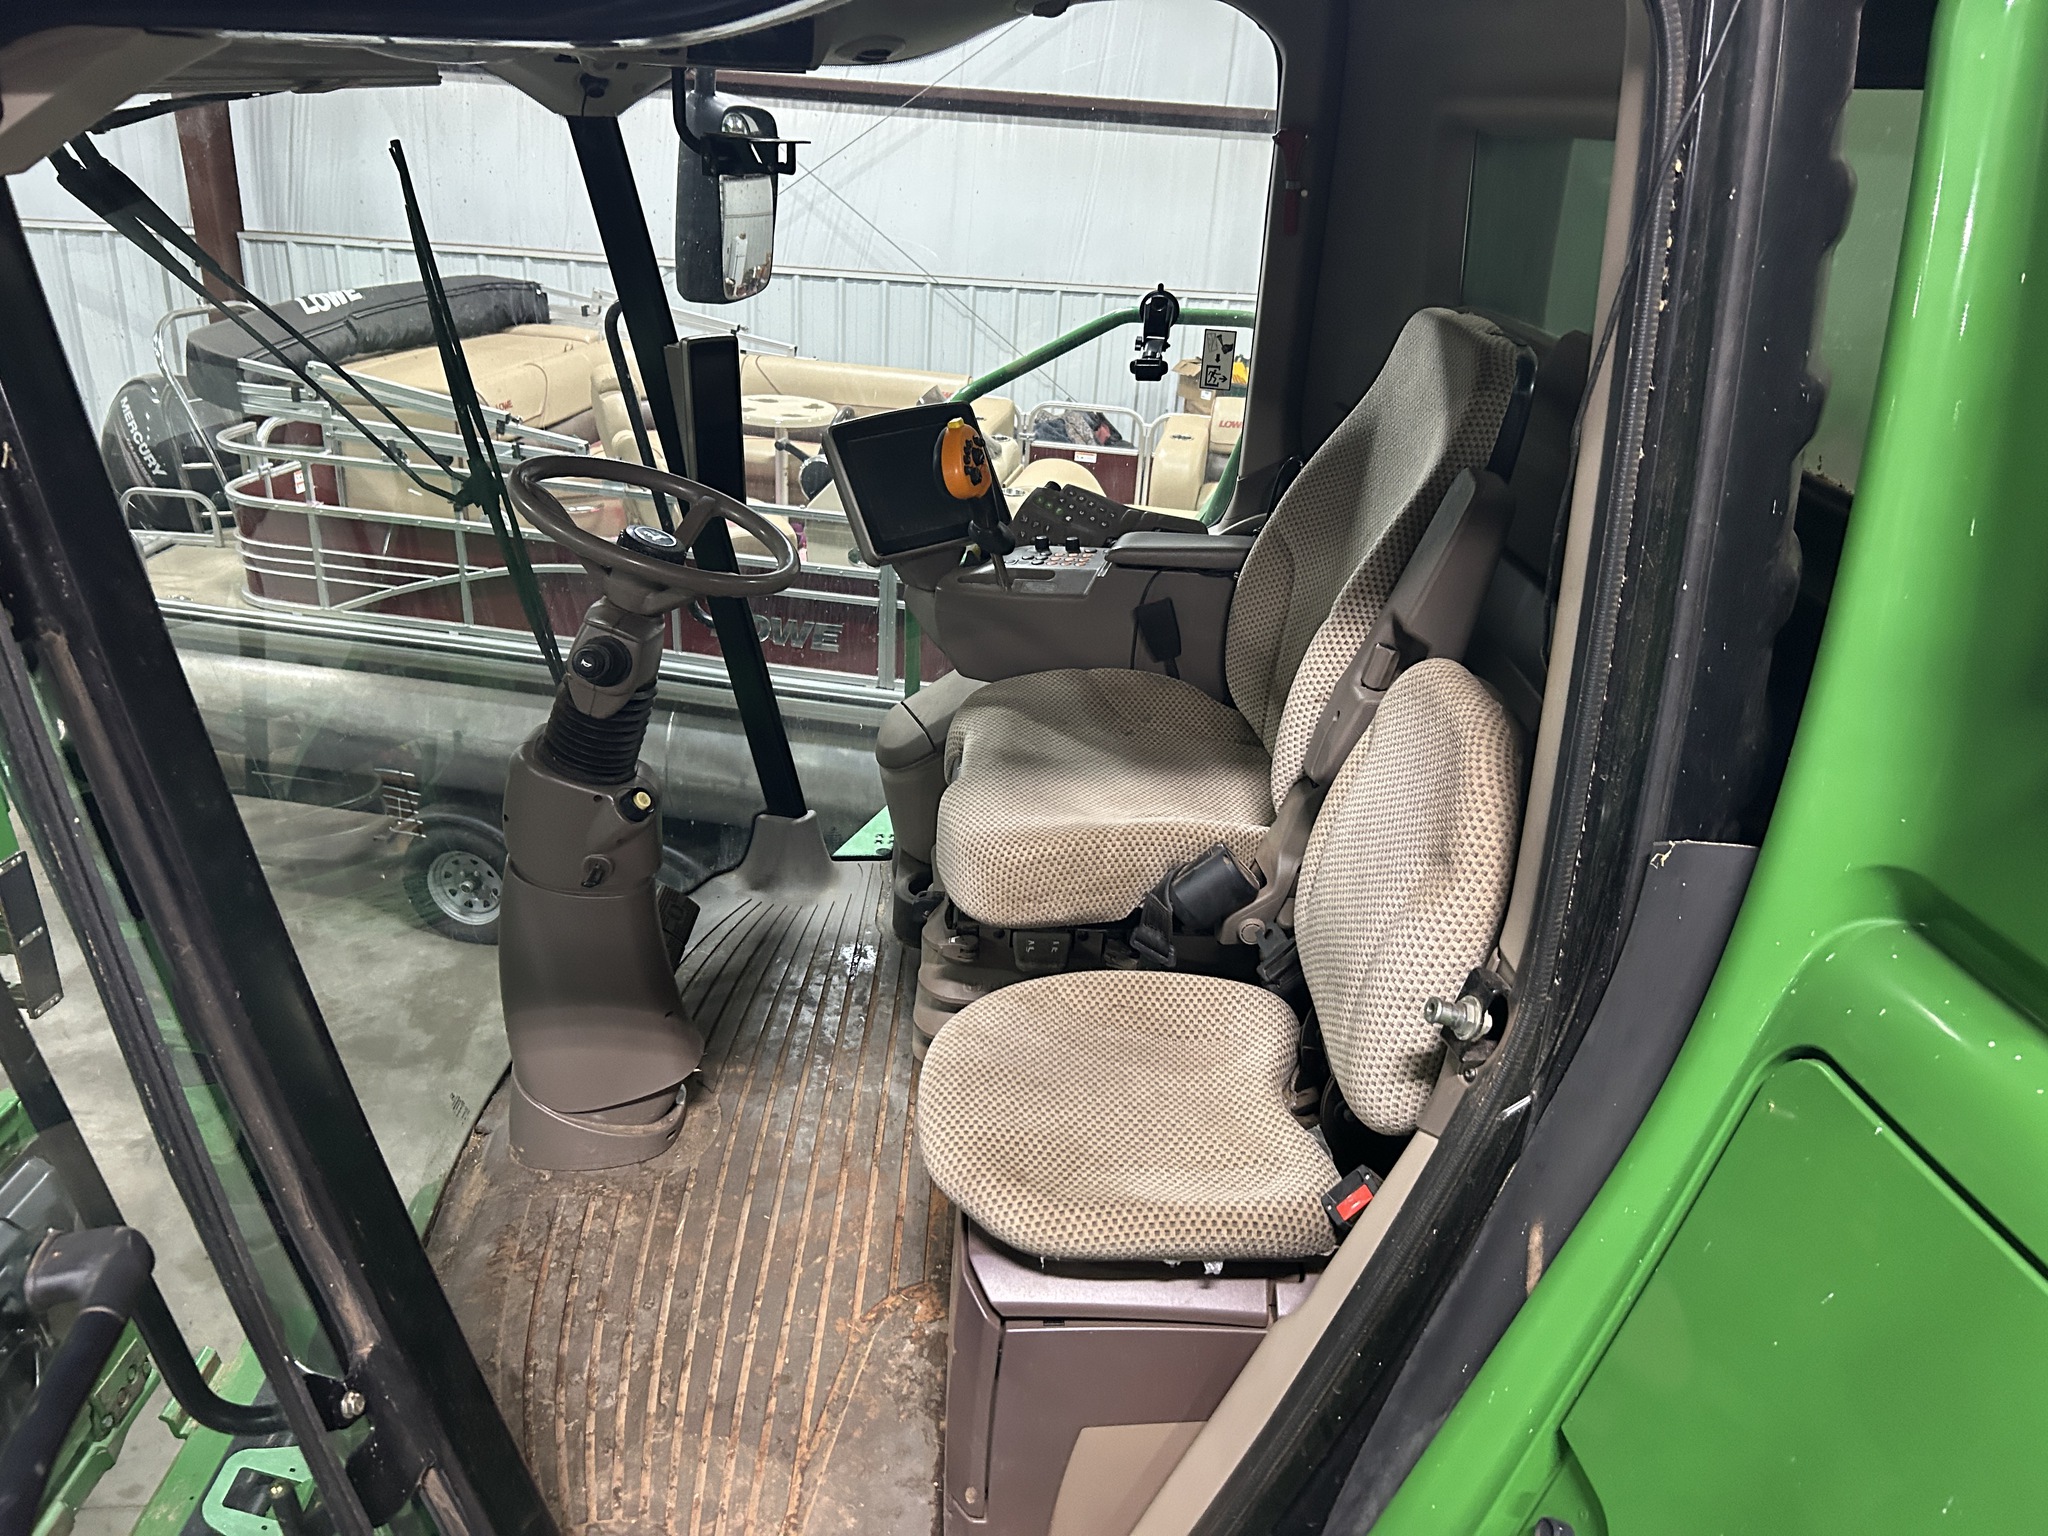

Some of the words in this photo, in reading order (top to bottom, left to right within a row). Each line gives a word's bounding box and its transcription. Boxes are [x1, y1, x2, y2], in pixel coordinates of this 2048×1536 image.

[295, 289, 363, 315] LOWE
[120, 396, 167, 475] MERCURY
[711, 614, 844, 653] OWE
